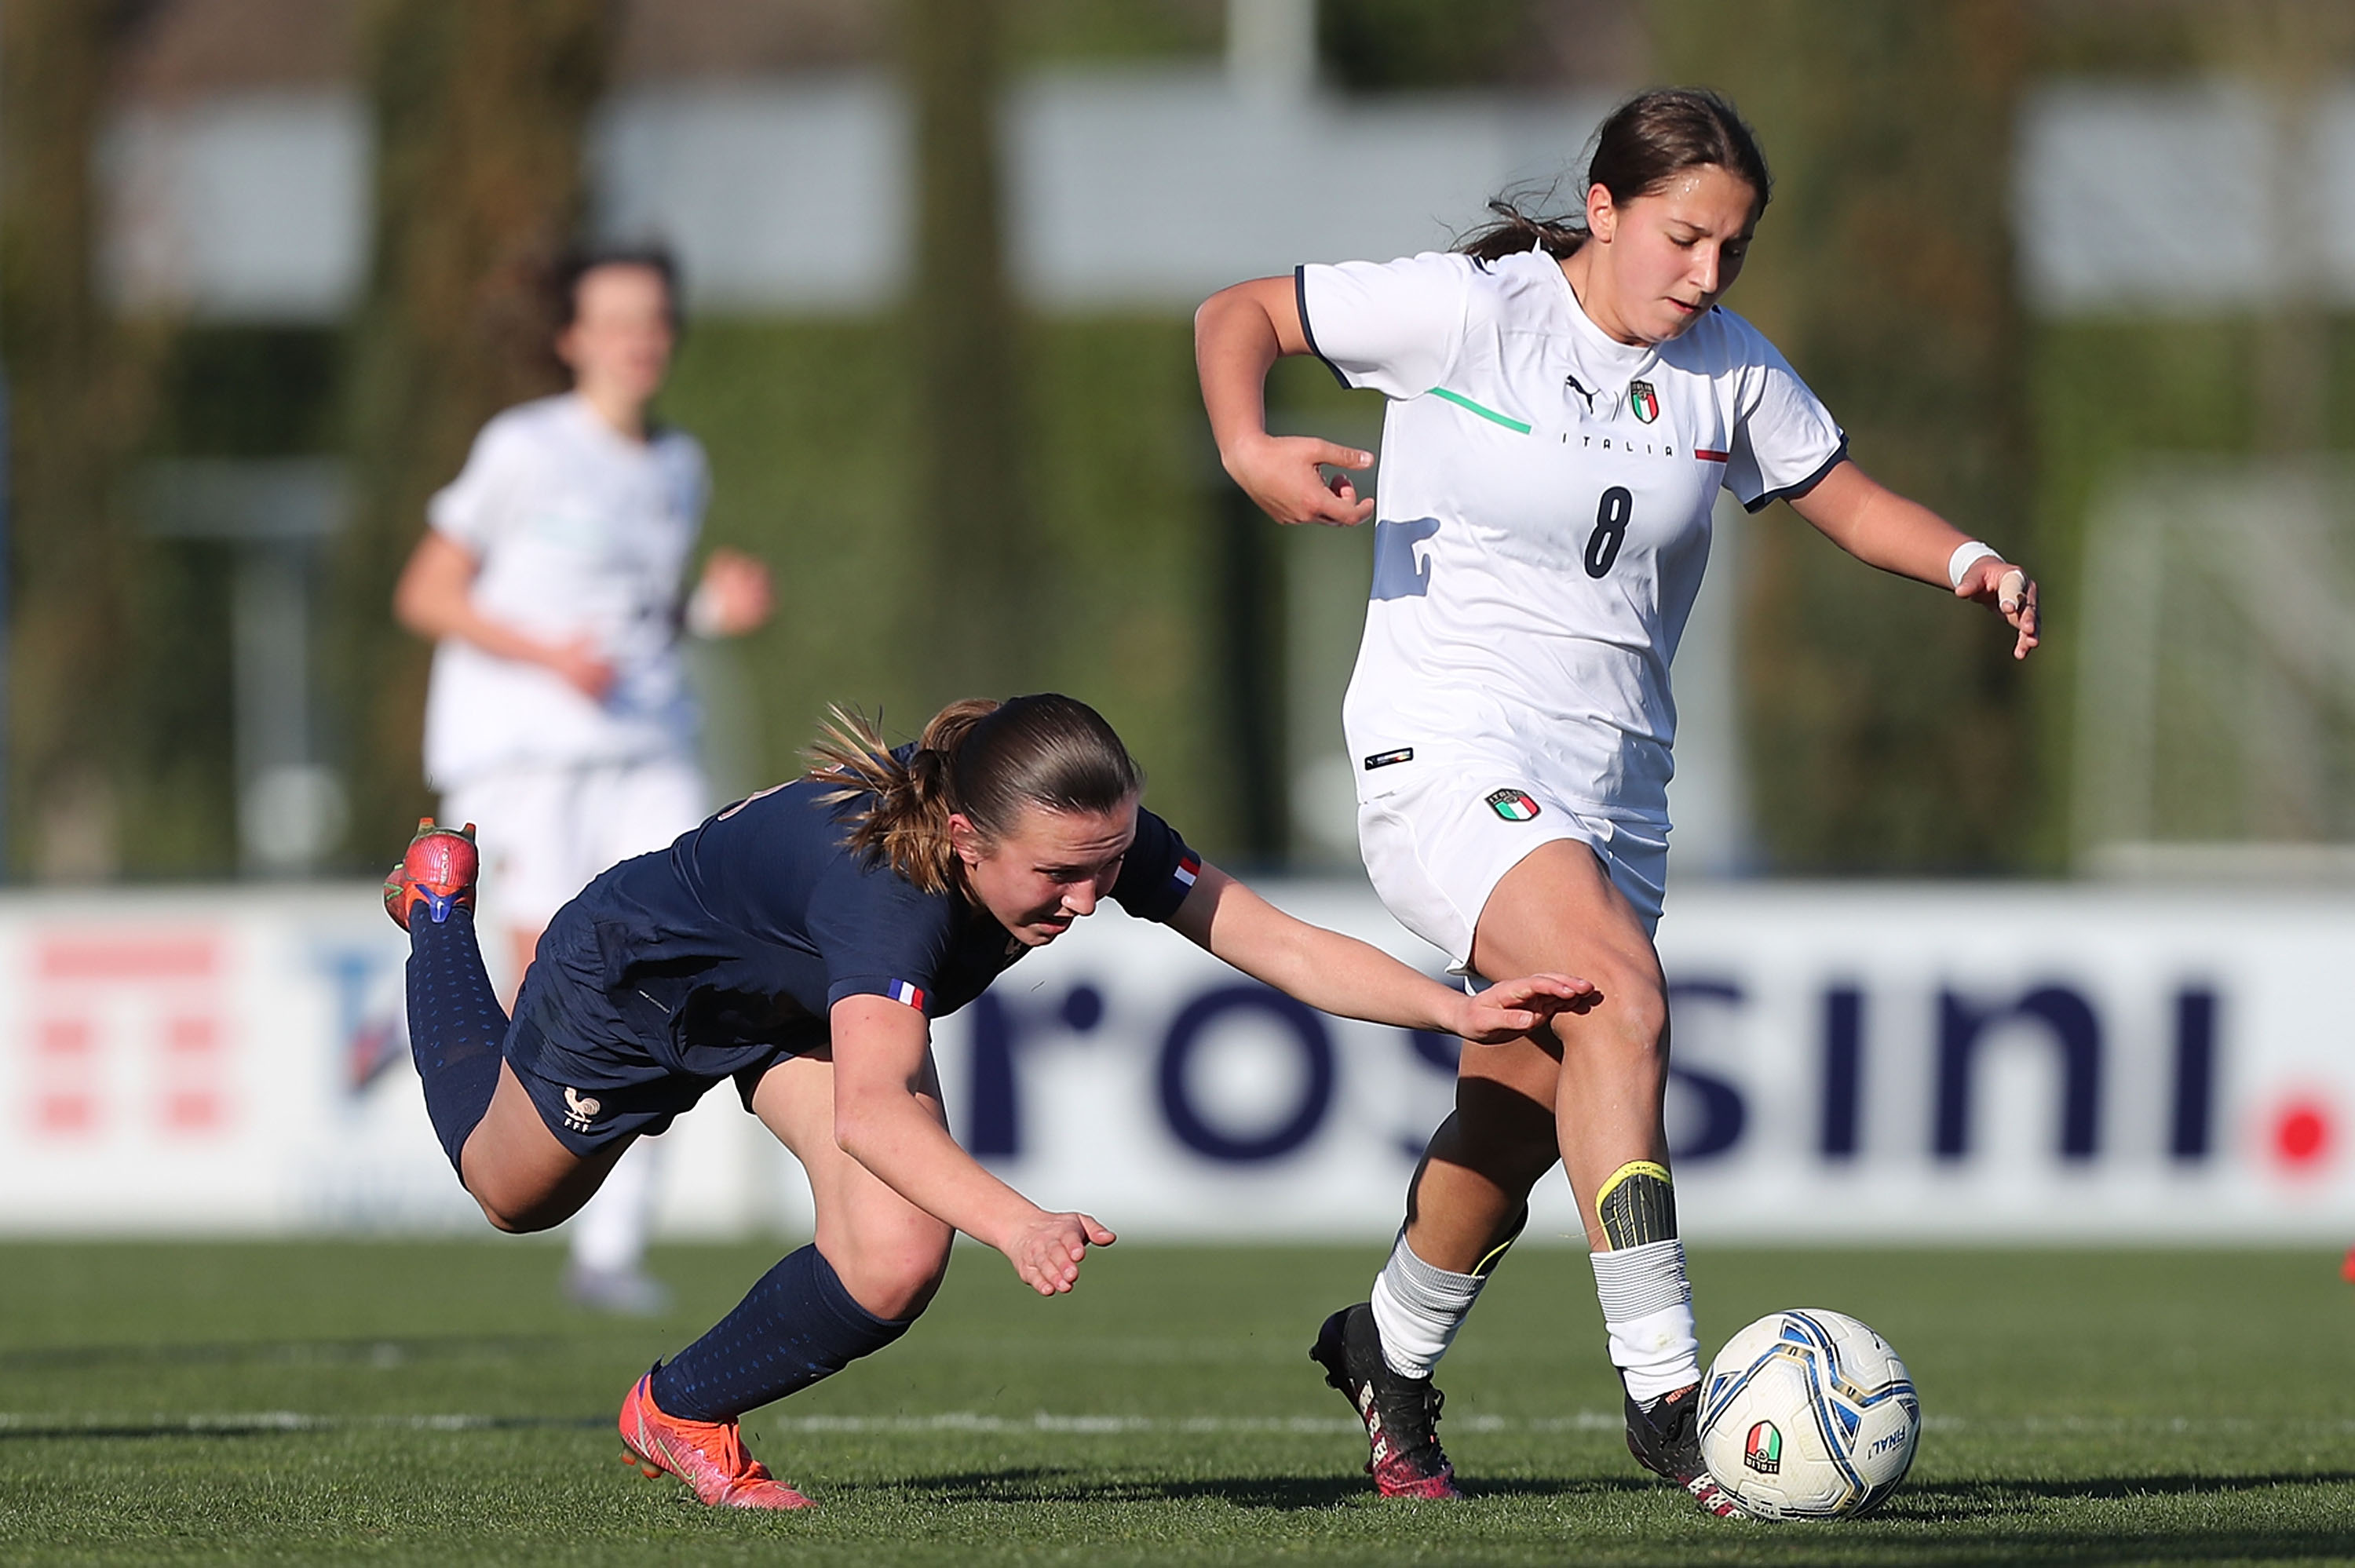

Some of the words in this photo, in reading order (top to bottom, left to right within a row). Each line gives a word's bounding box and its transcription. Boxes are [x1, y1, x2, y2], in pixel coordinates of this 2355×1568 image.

[1562, 432, 1673, 457] ITALIA
[1585, 486, 1632, 578] 8
[1746, 1457, 1777, 1472] ITALIA
